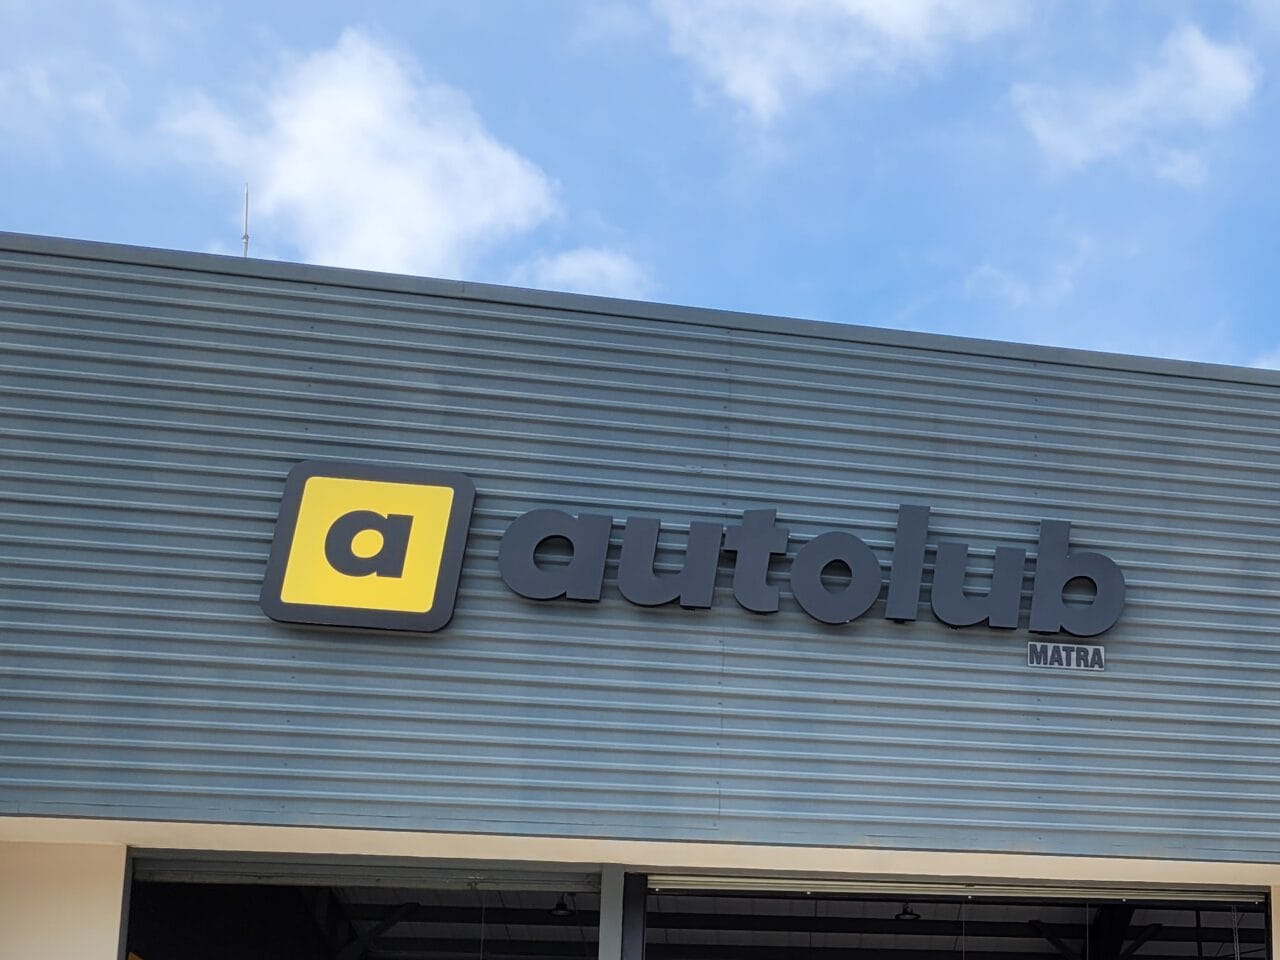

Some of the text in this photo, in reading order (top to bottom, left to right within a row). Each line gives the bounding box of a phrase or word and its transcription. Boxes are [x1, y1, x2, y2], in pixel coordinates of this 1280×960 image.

[324, 509, 414, 579] a
[498, 503, 1126, 637] autolub
[1028, 643, 1104, 668] MATRA
